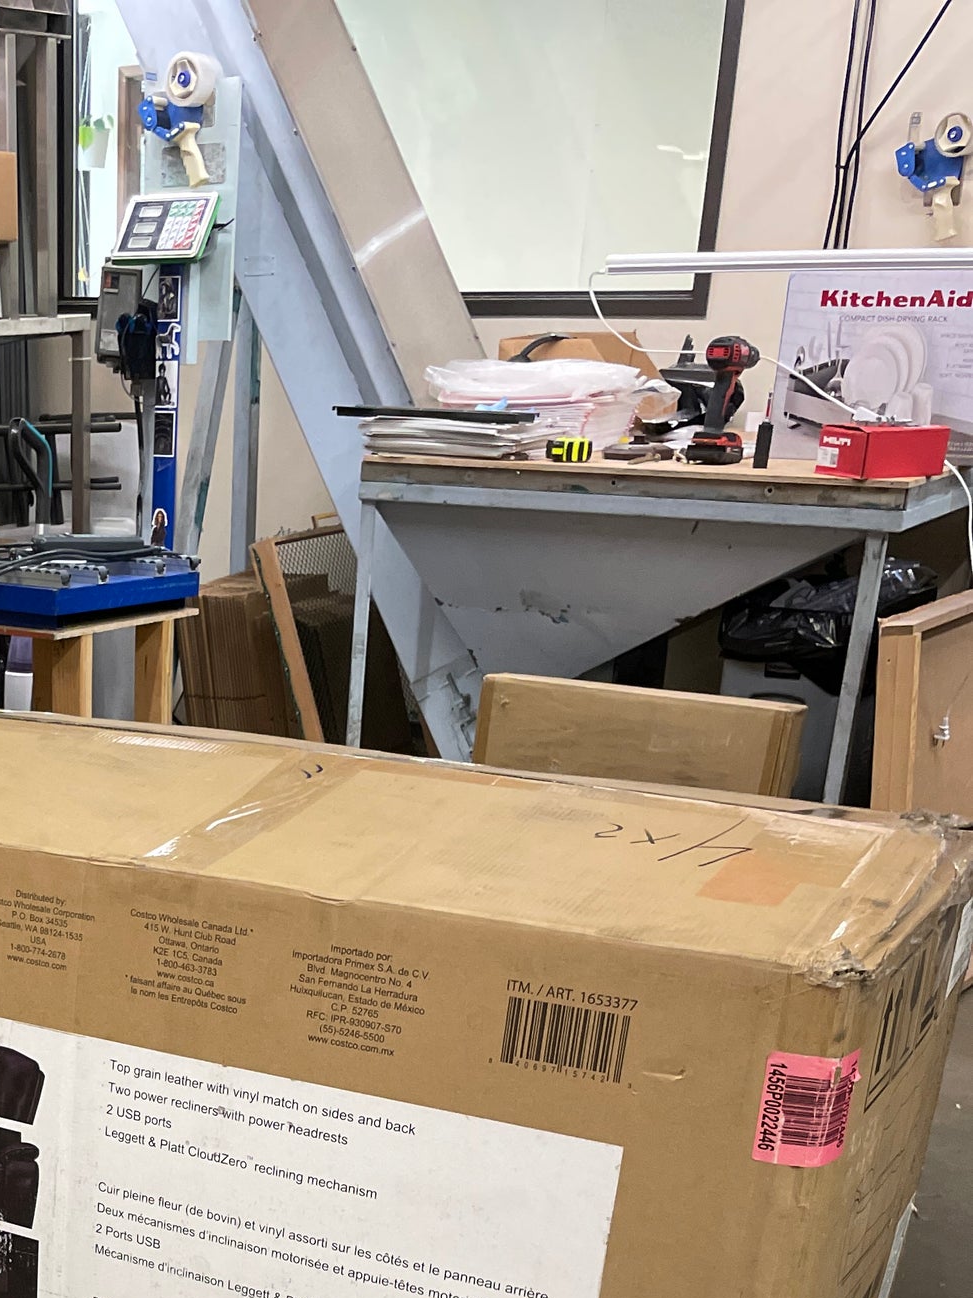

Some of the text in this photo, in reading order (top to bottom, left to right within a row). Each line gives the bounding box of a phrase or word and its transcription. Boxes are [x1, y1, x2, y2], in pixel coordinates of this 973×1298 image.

[820, 289, 973, 308] KitchenAid
[839, 315, 876, 323] COMPACT
[823, 435, 851, 446] HILTI
[130, 908, 157, 920] Costco
[158, 912, 199, 928] Wholesale
[201, 920, 232, 933] Canada
[6, 954, 66, 970] www.costco.com
[156, 970, 214, 987] www.costco.ca
[506, 979, 533, 994] ITM.
[545, 985, 574, 1001] ART.
[581, 991, 638, 1011] 1653377
[307, 1034, 394, 1056] www.costco.com.mx
[319, 1023, 384, 1043] (55)-5246-5500
[110, 1058, 415, 1135] Top grain leather with vinyl match on sides and back
[757, 1063, 788, 1152] 1456P0022446
[106, 1103, 171, 1128] 2 USB ports
[108, 1081, 347, 1145] Two power recliners with power headrests
[104, 1126, 144, 1145] Leggett
[147, 1136, 156, 1147] &
[254, 1163, 303, 1184] reclining
[307, 1176, 377, 1199] mechanism
[98, 1181, 120, 1195] Cuir
[122, 1189, 154, 1204] pleine
[158, 1196, 182, 1211] fleur
[185, 1203, 203, 1217] (de
[206, 1208, 241, 1228] bovin)
[244, 1220, 255, 1230] et
[258, 1224, 284, 1239] vinyl
[288, 1231, 327, 1248] assorti
[331, 1242, 350, 1253] sur
[354, 1245, 371, 1259] les
[375, 1252, 408, 1268] côtés
[412, 1262, 424, 1272] et
[428, 1263, 439, 1275] le
[443, 1269, 500, 1290] panneau
[97, 1202, 123, 1218] Deux
[127, 1212, 195, 1237] mécanismes
[198, 1229, 267, 1255] d'inclinaison
[271, 1249, 329, 1271] motorisée
[332, 1265, 344, 1275] et
[347, 1269, 424, 1295] appuie-têtes
[94, 1243, 154, 1268] Mécanisme
[157, 1262, 223, 1287] d'inclinaison
